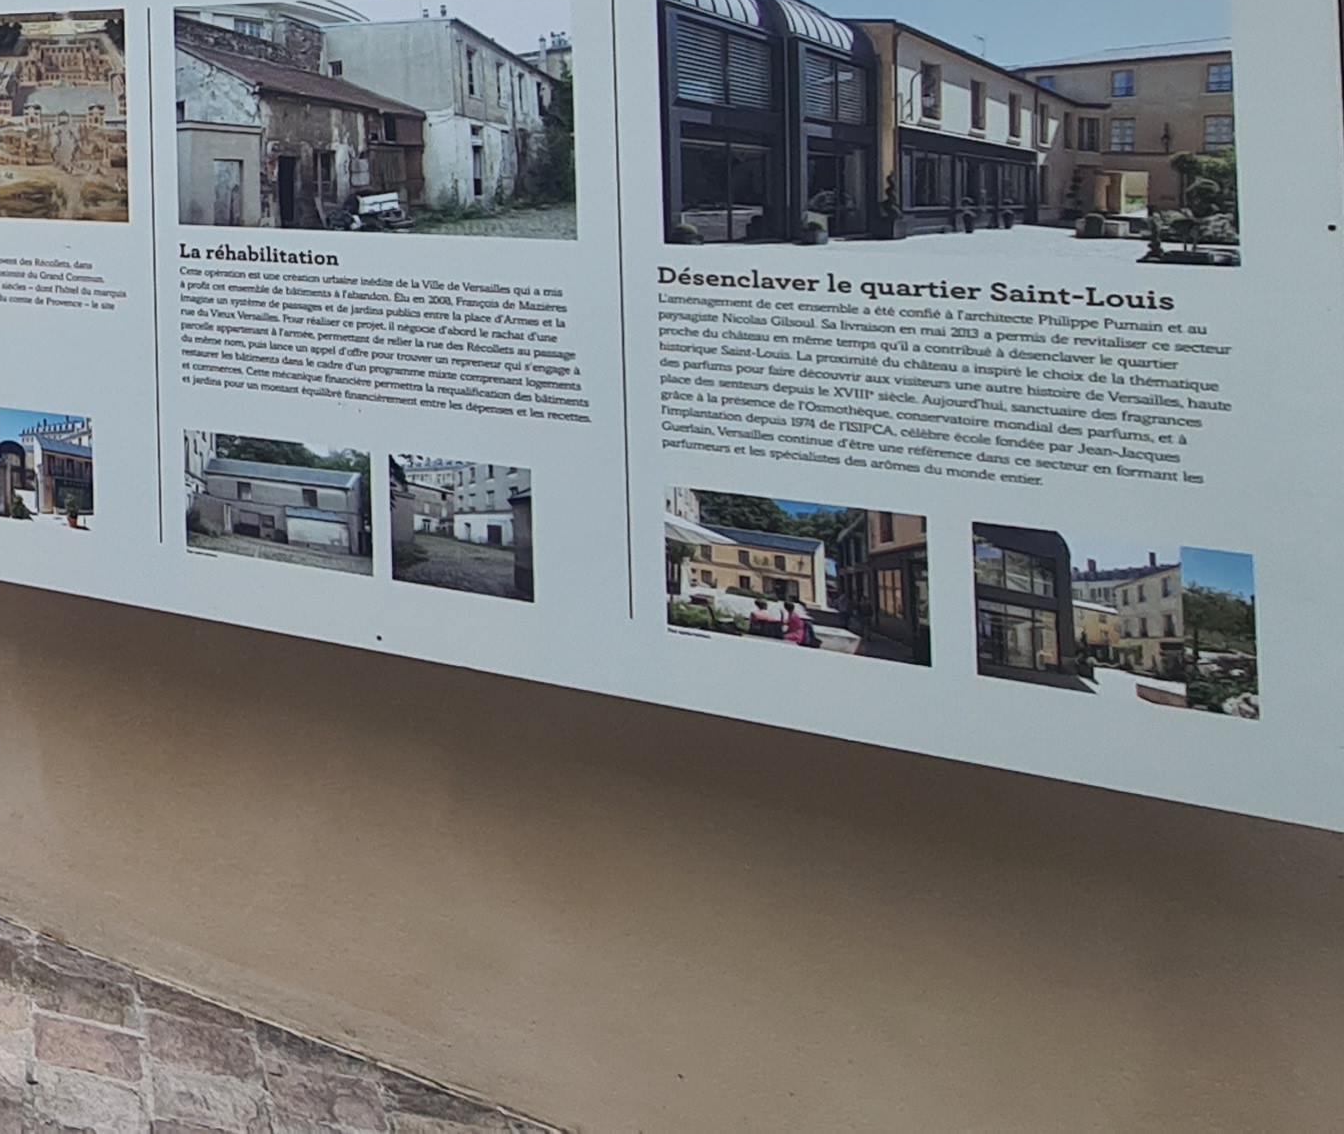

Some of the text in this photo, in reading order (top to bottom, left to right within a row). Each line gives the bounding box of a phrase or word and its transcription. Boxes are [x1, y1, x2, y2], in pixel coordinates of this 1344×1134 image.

[179, 244, 339, 266] La réhabilitation
[657, 267, 1175, 311] Désenclaver le quartier Saint-Louis
[658, 308, 718, 324] paysagiste
[721, 312, 767, 325] Nicolas
[820, 318, 836, 329] Sa
[839, 319, 895, 333] livraison
[898, 325, 916, 334] en
[919, 324, 946, 336] mai
[950, 326, 979, 338] 2013
[983, 330, 992, 339] a
[995, 328, 1046, 345] permis
[1050, 332, 1069, 344] de
[1073, 333, 1147, 349] revitaliser
[1151, 340, 1170, 350] ce
[1173, 339, 1231, 354] secteur
[755, 297, 771, 308] de
[774, 298, 794, 310] cet
[797, 300, 859, 313] ensemble
[862, 306, 870, 314] a
[873, 304, 895, 316] été
[898, 305, 941, 318] confié
[944, 308, 953, 319] à
[957, 309, 1033, 324] l'architecte
[1037, 313, 1099, 330] Philippe
[1167, 320, 1182, 332] et
[1186, 324, 1207, 334] au
[658, 324, 1179, 372] proche du château en même temps qu'il a contribué à désenclaver le quartier
[659, 340, 717, 357] historique
[796, 350, 812, 361] La
[815, 351, 878, 368] proximité
[881, 355, 900, 367] du
[903, 357, 957, 371] château
[961, 364, 970, 372] a
[973, 362, 1021, 379] inspiré
[1025, 366, 1038, 377] le
[1042, 367, 1083, 381] choix
[1087, 370, 1107, 382] de
[1110, 371, 1124, 384] la
[1128, 373, 1219, 394] thématique
[661, 436, 1042, 485] parfumeurs et les spécialistes des arômes du monde entier.
